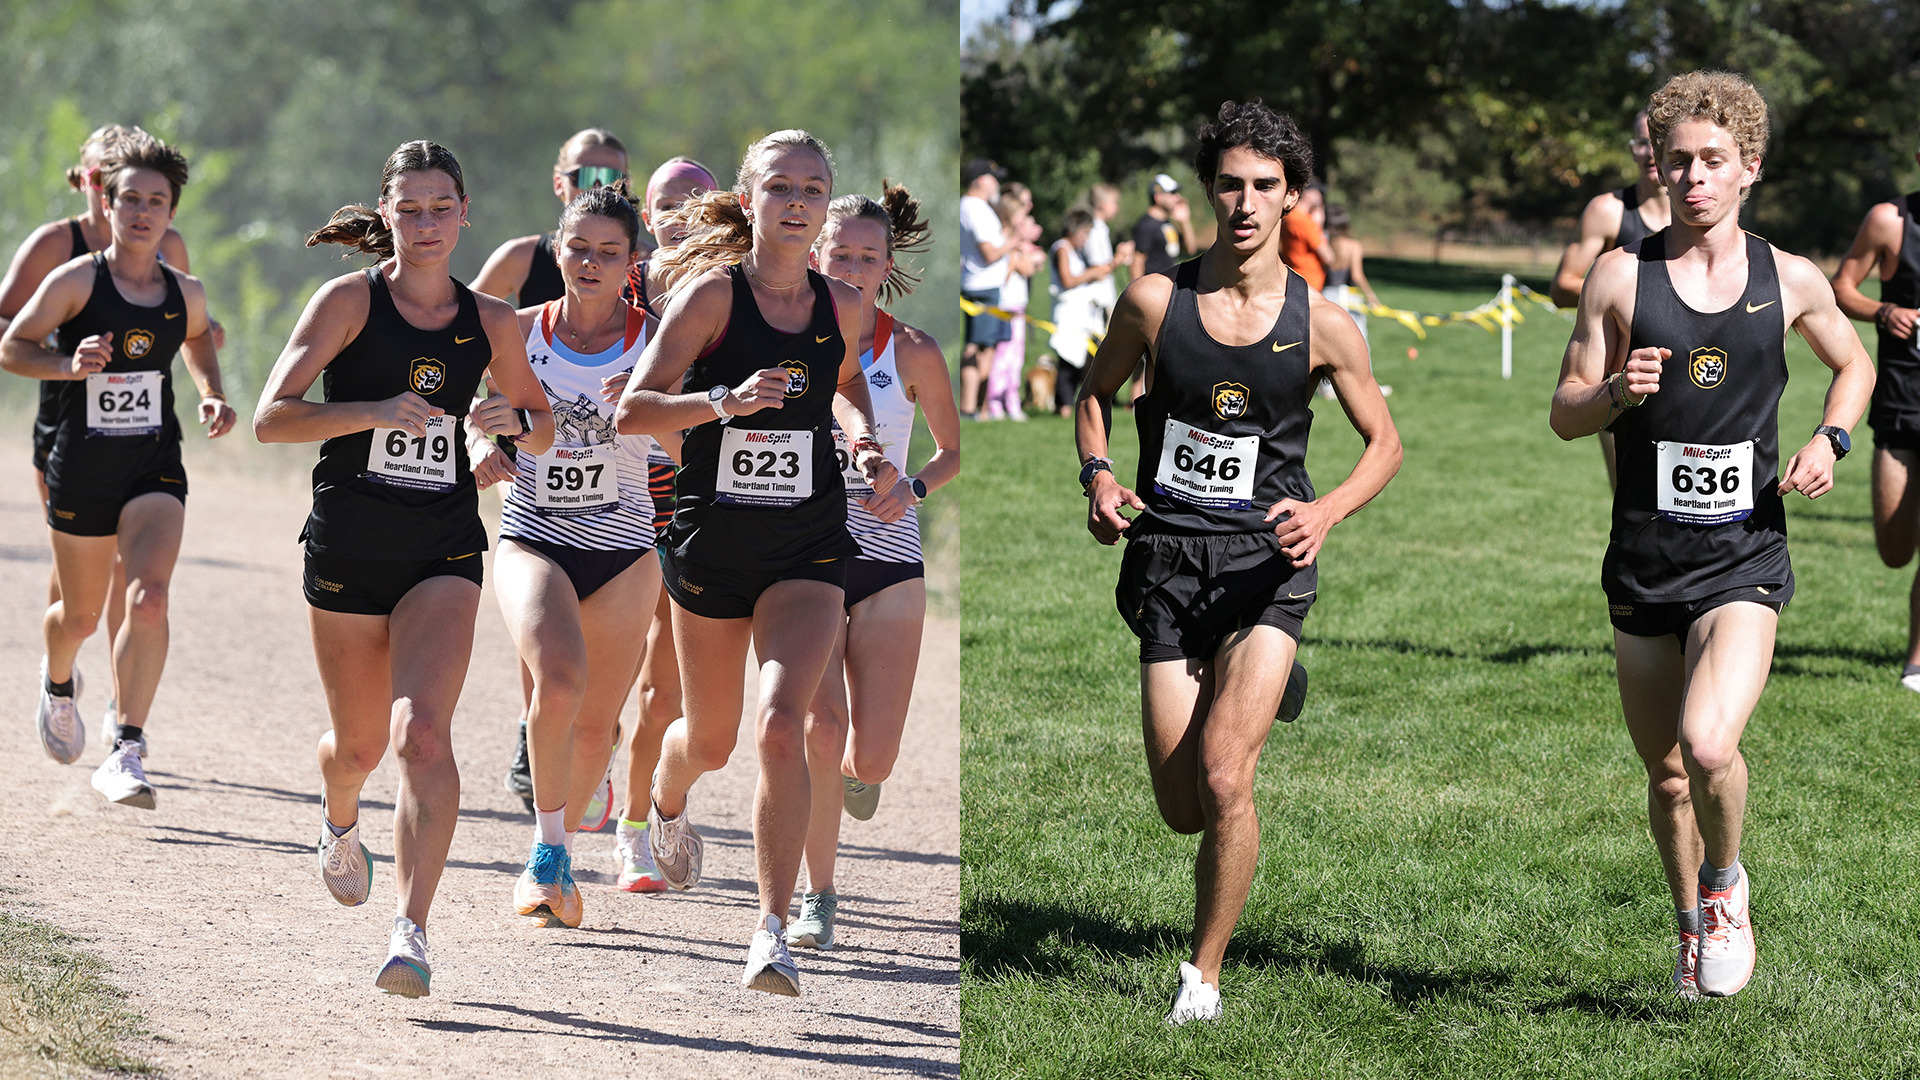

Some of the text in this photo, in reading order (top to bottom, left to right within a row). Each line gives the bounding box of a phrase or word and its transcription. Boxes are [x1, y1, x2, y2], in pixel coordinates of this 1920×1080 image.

[99, 389, 151, 412] 624
[385, 430, 449, 463] 619
[745, 432, 791, 445] MileSplit
[1187, 429, 1235, 450] MileSplit
[556, 449, 593, 461] MileSplit
[1174, 444, 1242, 481] 646
[1682, 446, 1732, 461] MileSplit
[384, 461, 444, 478] Heartland Timing
[732, 450, 800, 479] 623
[546, 464, 604, 491] 597
[732, 480, 796, 493] Heartland Timing
[1171, 473, 1234, 494] Heartland Timing
[1671, 464, 1740, 496] 636
[548, 493, 604, 503] Heartland Timing
[1673, 497, 1736, 509] Heartland Timing
